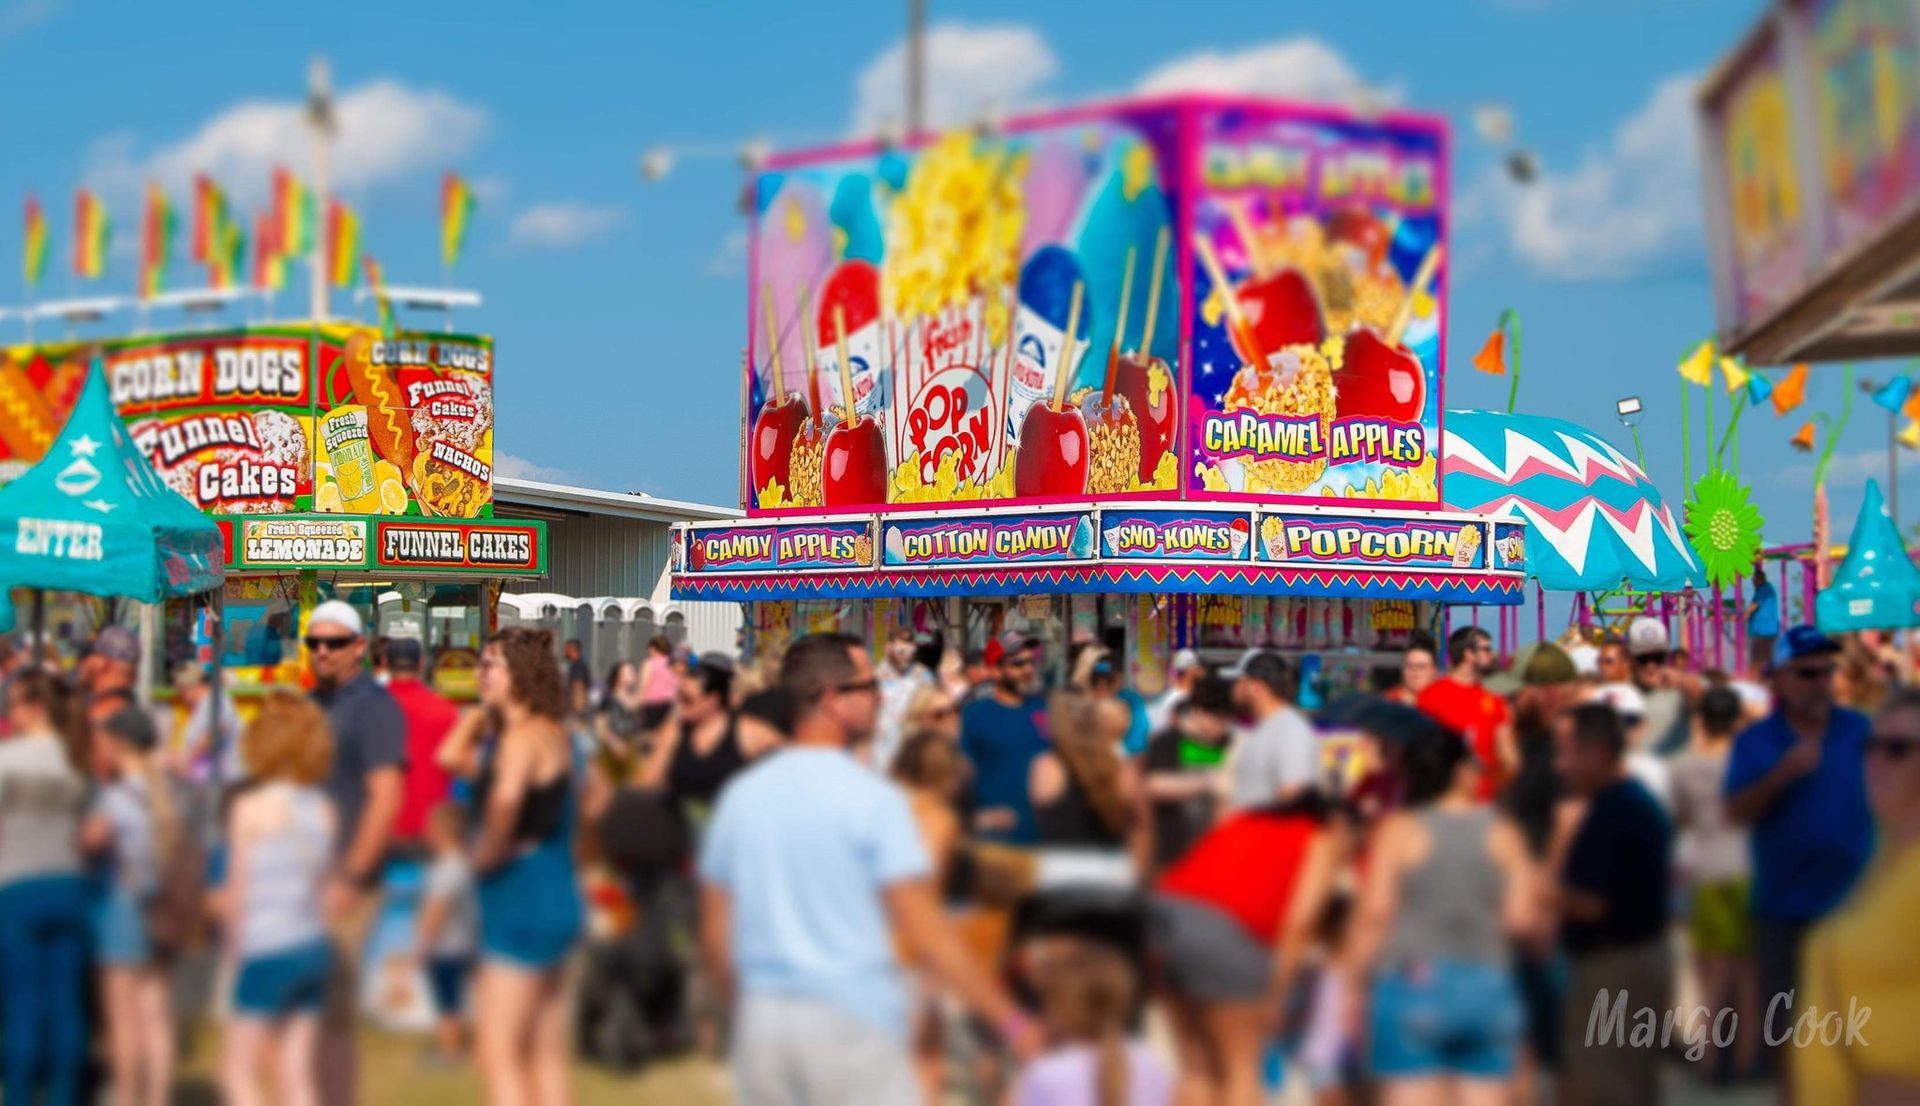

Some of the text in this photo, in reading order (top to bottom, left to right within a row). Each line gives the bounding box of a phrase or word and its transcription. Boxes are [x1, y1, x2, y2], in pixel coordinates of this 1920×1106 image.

[371, 341, 489, 372] CORN DOGS
[110, 347, 302, 403] CORN DOGS
[407, 378, 472, 408] Funnel
[328, 413, 357, 431] Fresh
[431, 401, 475, 418] Cakes
[909, 384, 968, 454] POP
[1205, 414, 1421, 461] CARAMEL APPLES
[432, 441, 491, 482] NACHOS
[199, 459, 297, 501] Cakes
[15, 517, 103, 560] ENTER
[267, 524, 343, 537] Fresh Squeezed
[385, 529, 530, 561] FUNNEL CAKES
[904, 525, 1072, 557] COTTON CANDY
[1119, 524, 1231, 550] SNO-KONES
[1286, 526, 1459, 558] POPCORN
[247, 537, 363, 561] LEMONADE
[706, 533, 855, 562] CANDY APPLES
